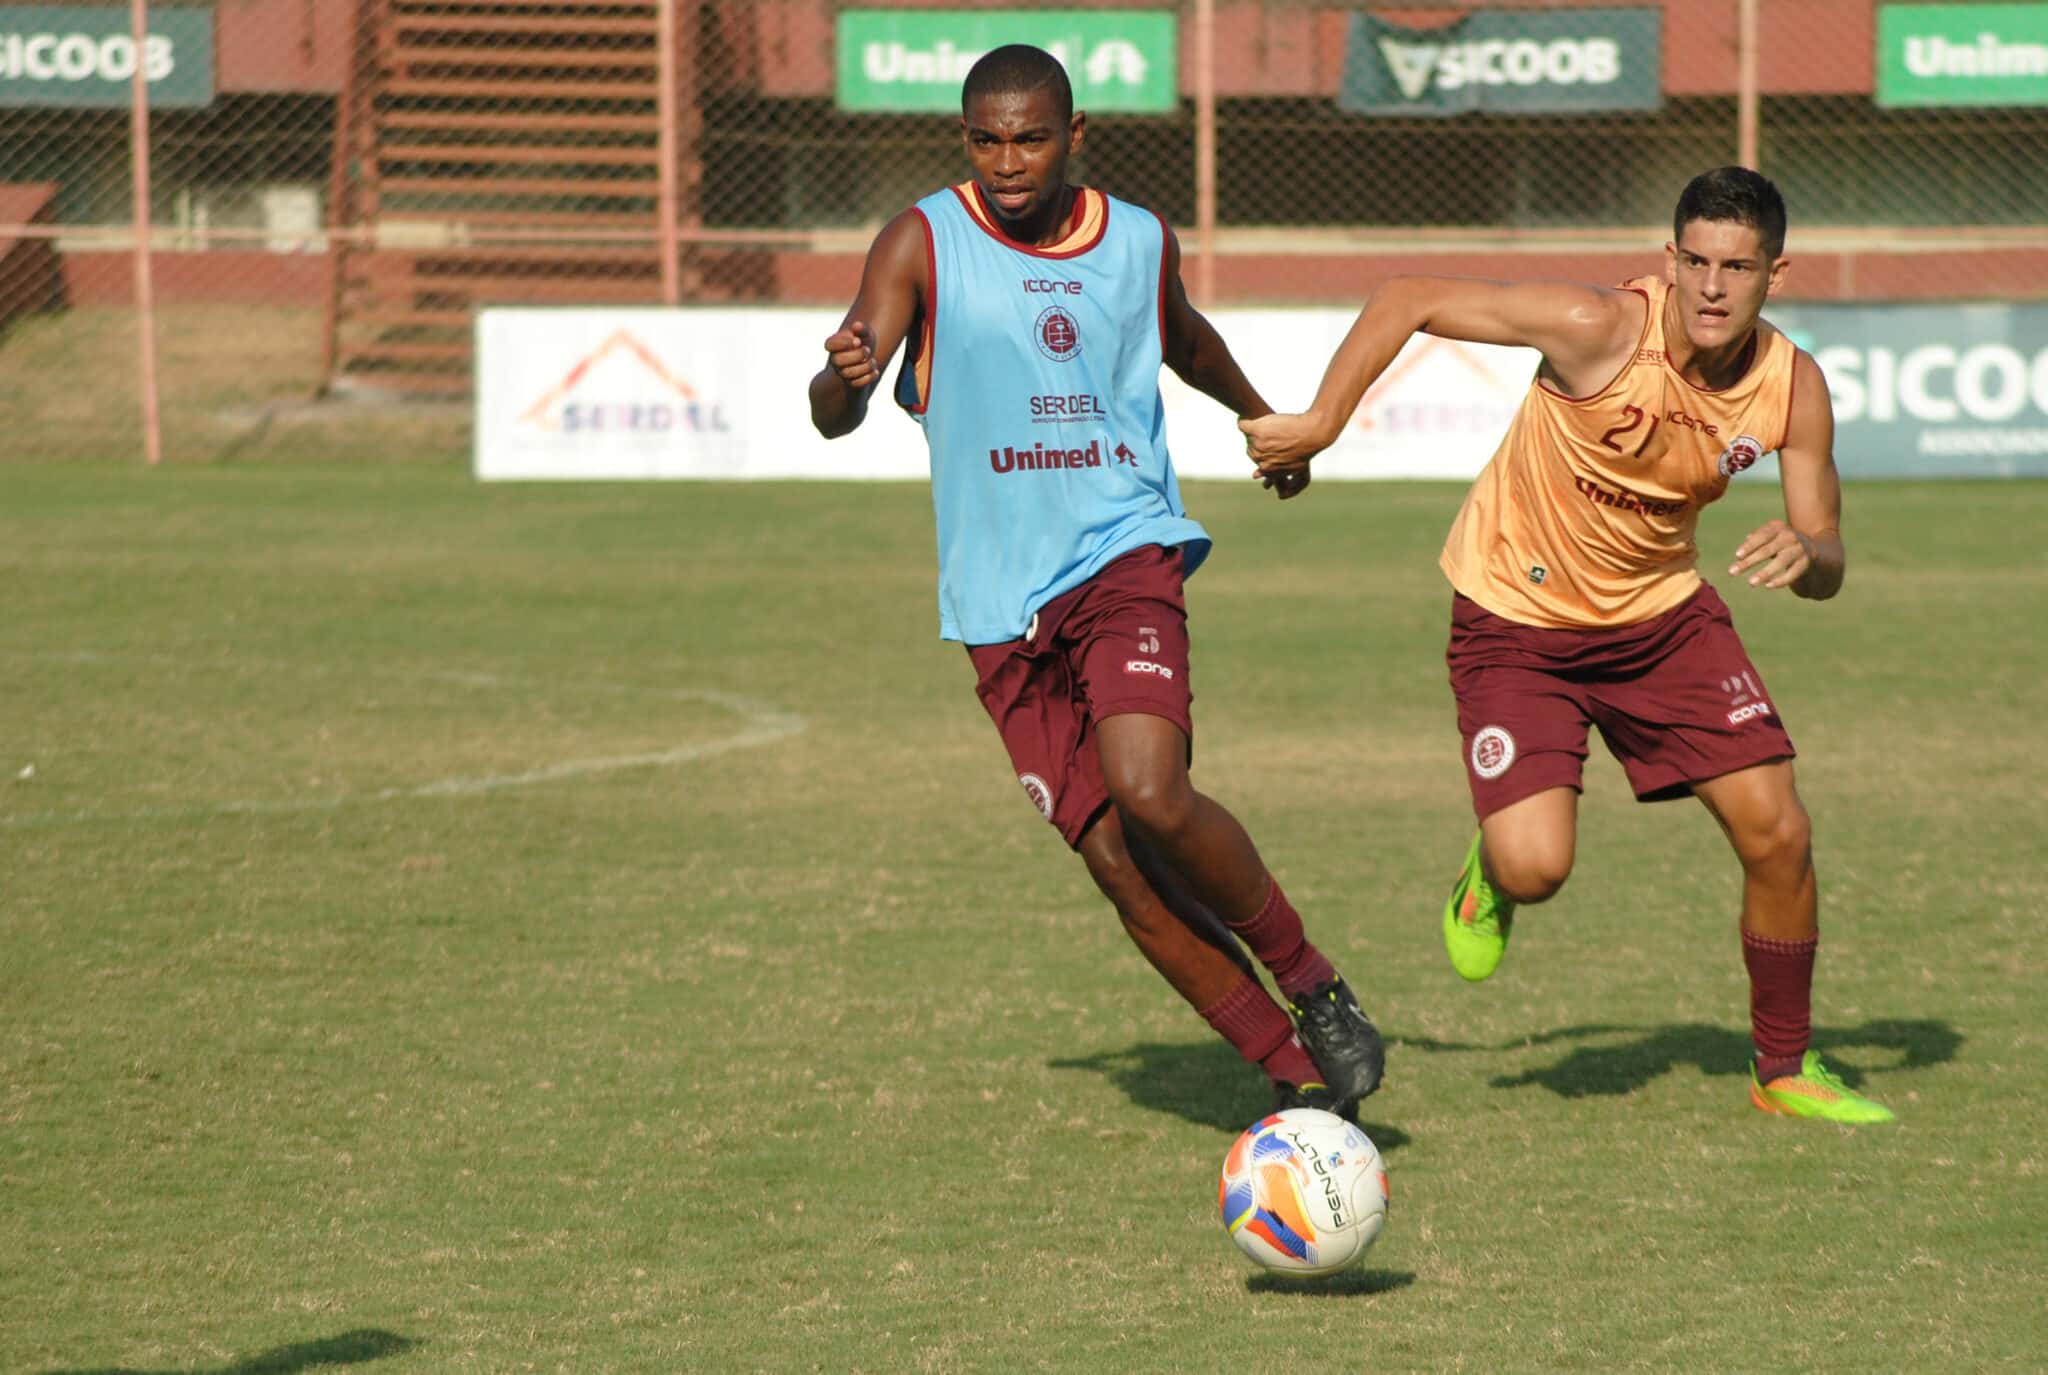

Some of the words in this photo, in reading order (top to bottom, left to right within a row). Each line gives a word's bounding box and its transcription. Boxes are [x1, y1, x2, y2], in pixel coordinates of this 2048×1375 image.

[0, 33, 175, 81] ICOOB
[863, 40, 1068, 83] Uni
[1436, 38, 1621, 90] SICOOB
[1030, 394, 1106, 415] SERDEL
[1814, 345, 2048, 422] SICO
[1600, 404, 1660, 459] 21
[990, 439, 1101, 474] Unimed
[1138, 627, 1160, 655] 5
[1288, 1131, 1347, 1229] PENALTY
